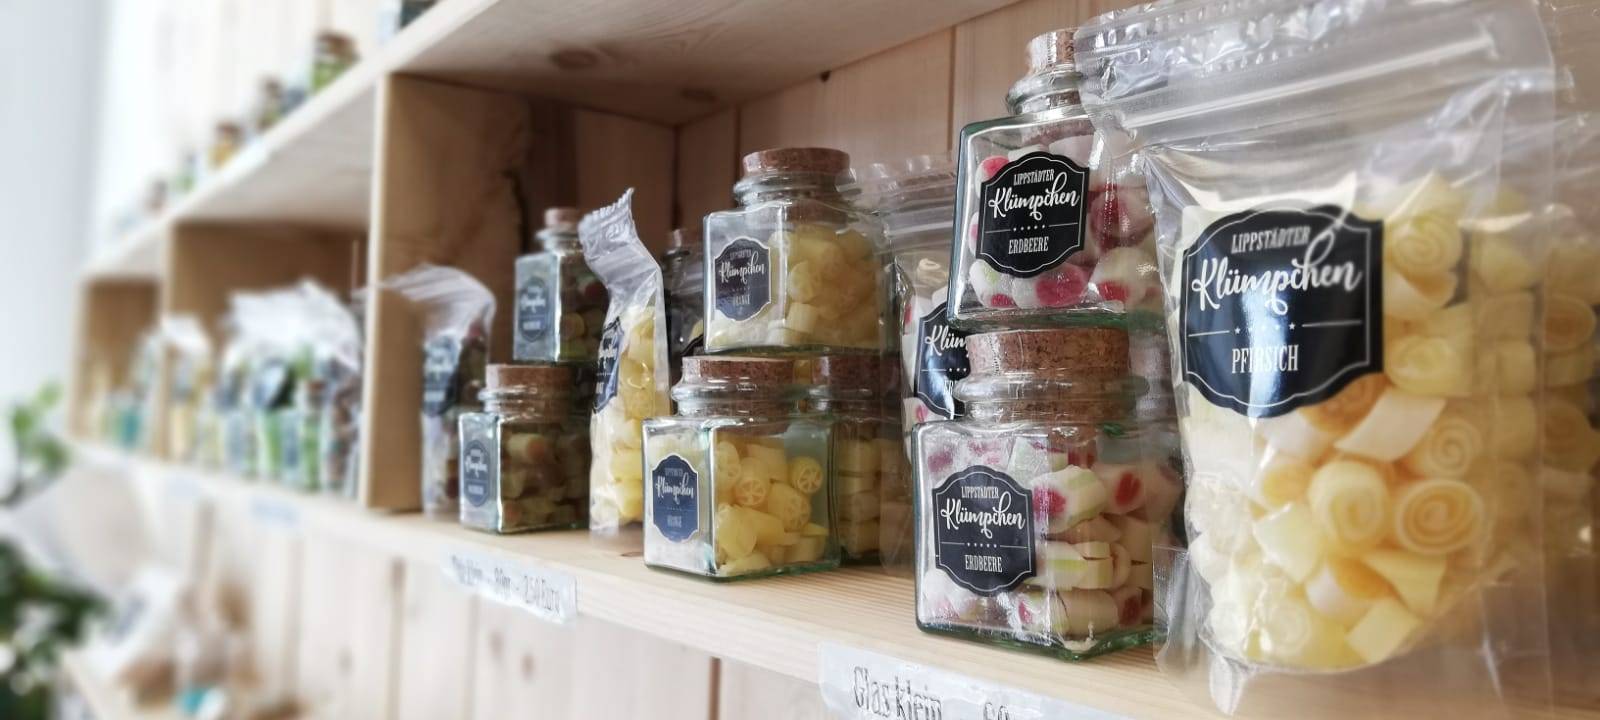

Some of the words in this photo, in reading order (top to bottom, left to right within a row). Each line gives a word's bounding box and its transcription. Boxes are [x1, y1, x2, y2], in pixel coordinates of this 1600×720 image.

[1013, 169, 1055, 185] LIPPSTÄDTER
[988, 171, 1080, 221] Klümpchen
[1008, 236, 1049, 255] ERDBEERE
[1231, 225, 1311, 254] LIPPSTÄDTER
[719, 251, 765, 284] Klümpchen
[1191, 229, 1362, 315] Klümpchen
[1232, 344, 1299, 374] PFIRSICH
[961, 486, 999, 499] LIPPSTÄDTER
[940, 491, 1025, 539] Klümpchen
[965, 555, 1003, 573] ERDBEERE
[854, 666, 891, 718] Glas
